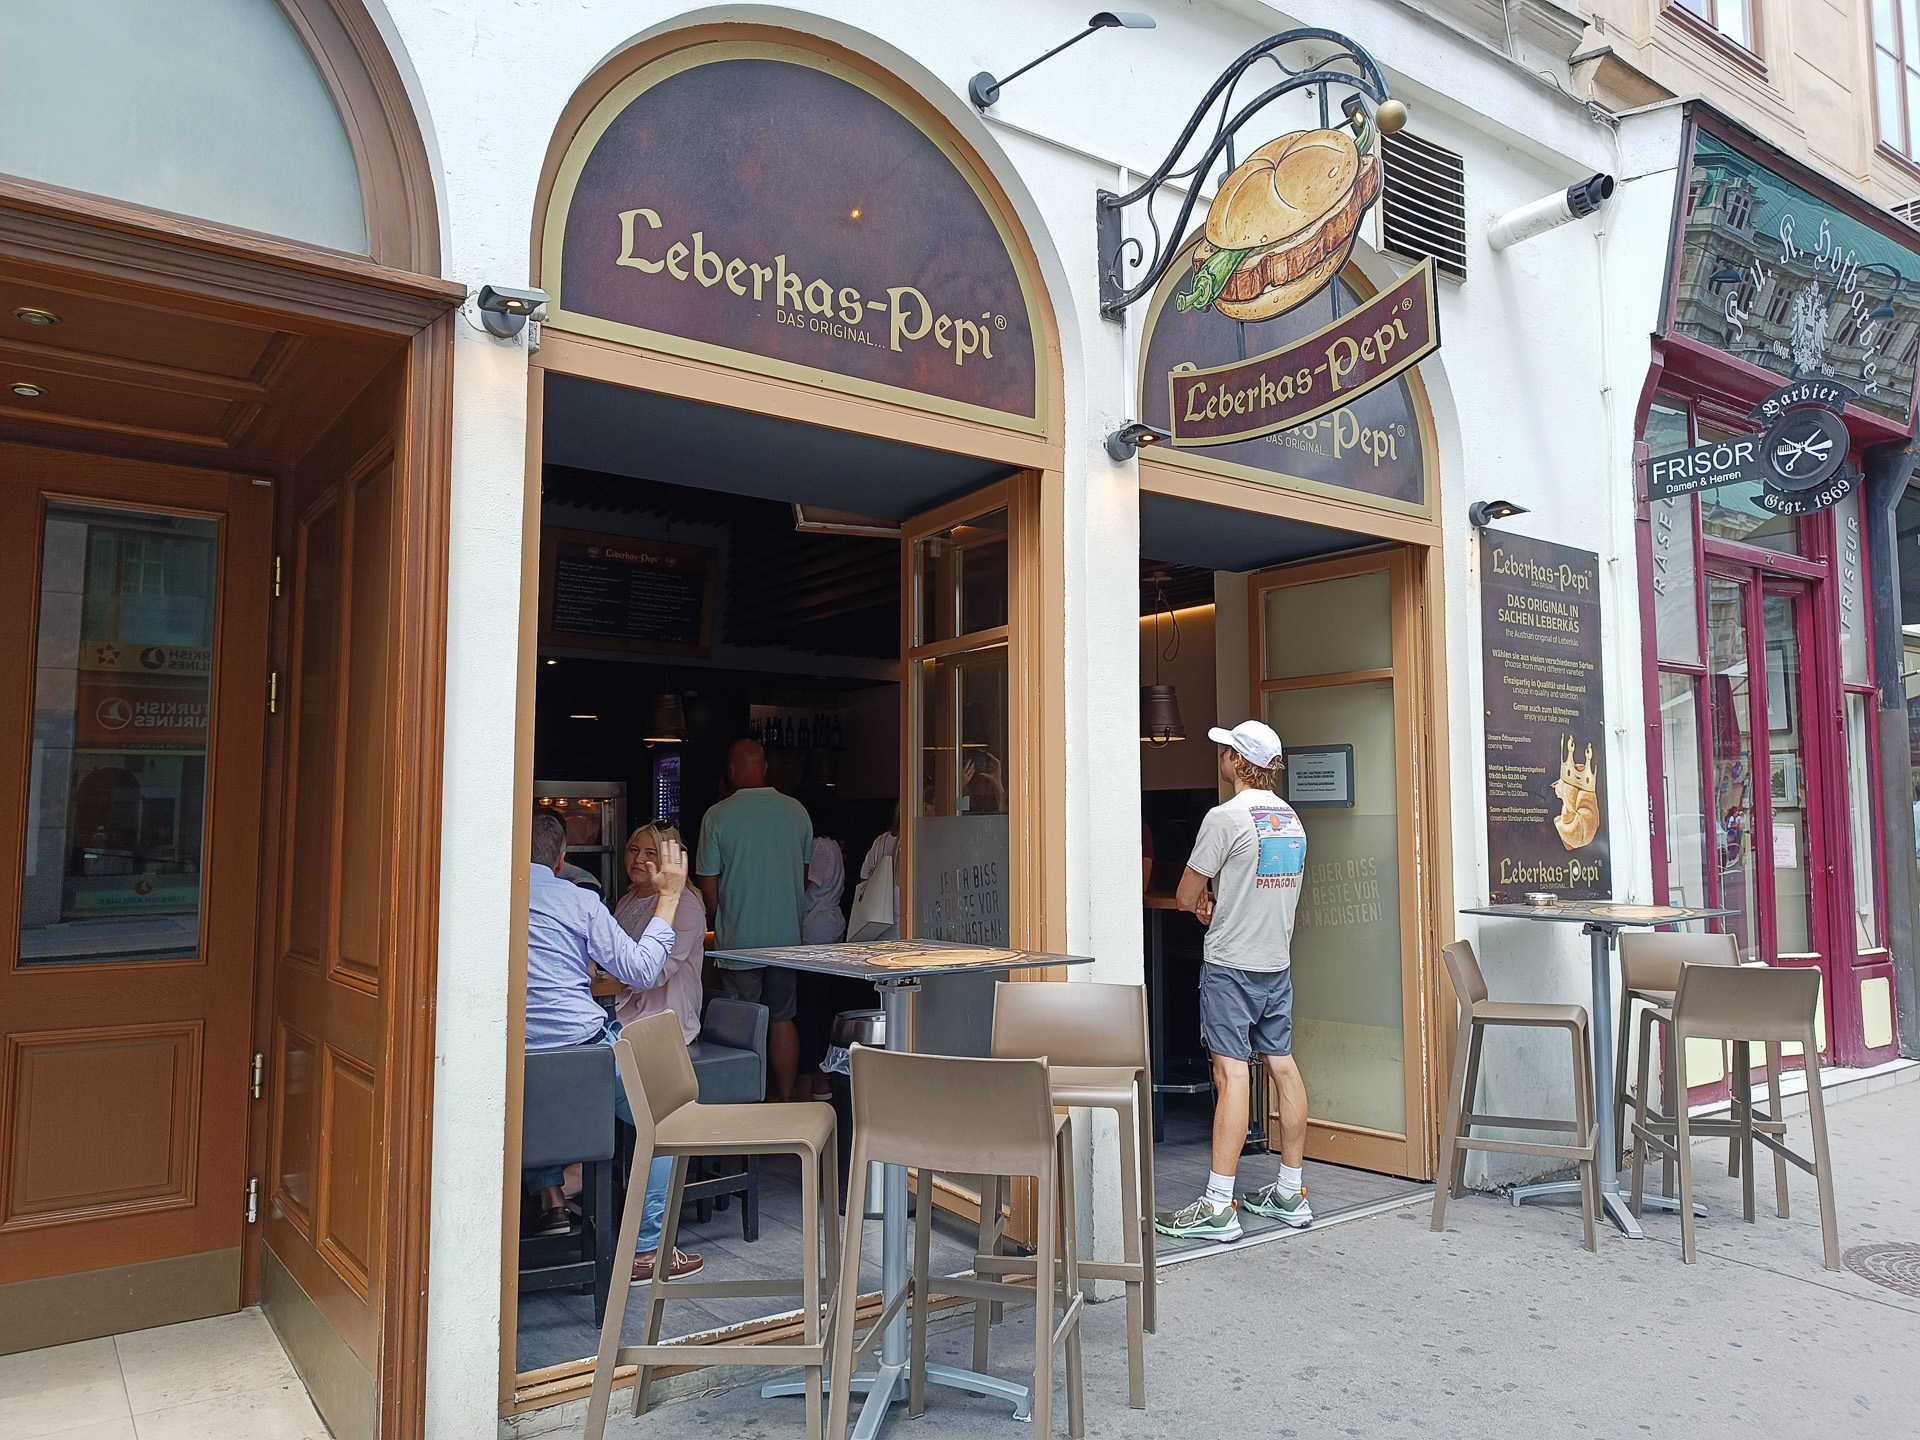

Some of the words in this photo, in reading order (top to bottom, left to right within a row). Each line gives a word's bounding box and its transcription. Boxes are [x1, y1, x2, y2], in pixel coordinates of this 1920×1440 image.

[776, 309, 805, 330] DAS
[1821, 364, 1835, 378] 1869
[1762, 384, 1840, 418] Barbier
[1265, 435, 1283, 446] DAS
[1652, 442, 1755, 485] FRISÖR
[1666, 480, 1698, 494] Damen
[1700, 477, 1707, 487] &
[1709, 470, 1742, 486] Herren
[1764, 493, 1807, 515] Gegr.
[1813, 479, 1850, 509] 1869
[1841, 516, 1858, 629] FRISEUR
[1507, 594, 1526, 609] DAS
[1527, 597, 1568, 616] ORIGINAL
[1570, 605, 1579, 618] IN
[1498, 608, 1535, 627] SACHEN
[1536, 614, 1580, 634] LEBERKÄS
[1506, 628, 1514, 637] the
[1515, 630, 1535, 640] Austrian
[1535, 632, 1552, 643] original
[1553, 635, 1558, 643] of
[1492, 649, 1511, 659] Wählen
[1530, 655, 1544, 664] vielen
[1545, 657, 1578, 667] verschiedenen
[1579, 661, 1594, 670] Sorten
[1505, 660, 1521, 669] choose
[1522, 661, 1533, 670] from
[1534, 663, 1546, 673] many
[1547, 665, 1566, 675] different
[1566, 668, 1584, 677] varieties
[1504, 676, 1530, 687] Einzigartig
[1530, 679, 1536, 687] in
[1536, 680, 1556, 690] Qualität
[1557, 682, 1565, 690] und
[1566, 683, 1586, 693] Auswahl
[1513, 687, 1528, 696] unique
[1535, 689, 1549, 698] quality
[1513, 702, 1528, 711] Gerne
[1529, 704, 1540, 712] auch
[1553, 706, 1579, 716] Mitnehmen
[1524, 713, 1537, 722] enjoy
[1488, 764, 1504, 772] Montag
[973, 862, 997, 888] BISS
[1346, 857, 1377, 879] BISS
[979, 890, 999, 915] VOR
[1312, 883, 1351, 906] BESTE
[1354, 880, 1380, 901] VOR
[1314, 902, 1383, 927] NÄCHSTEN!
